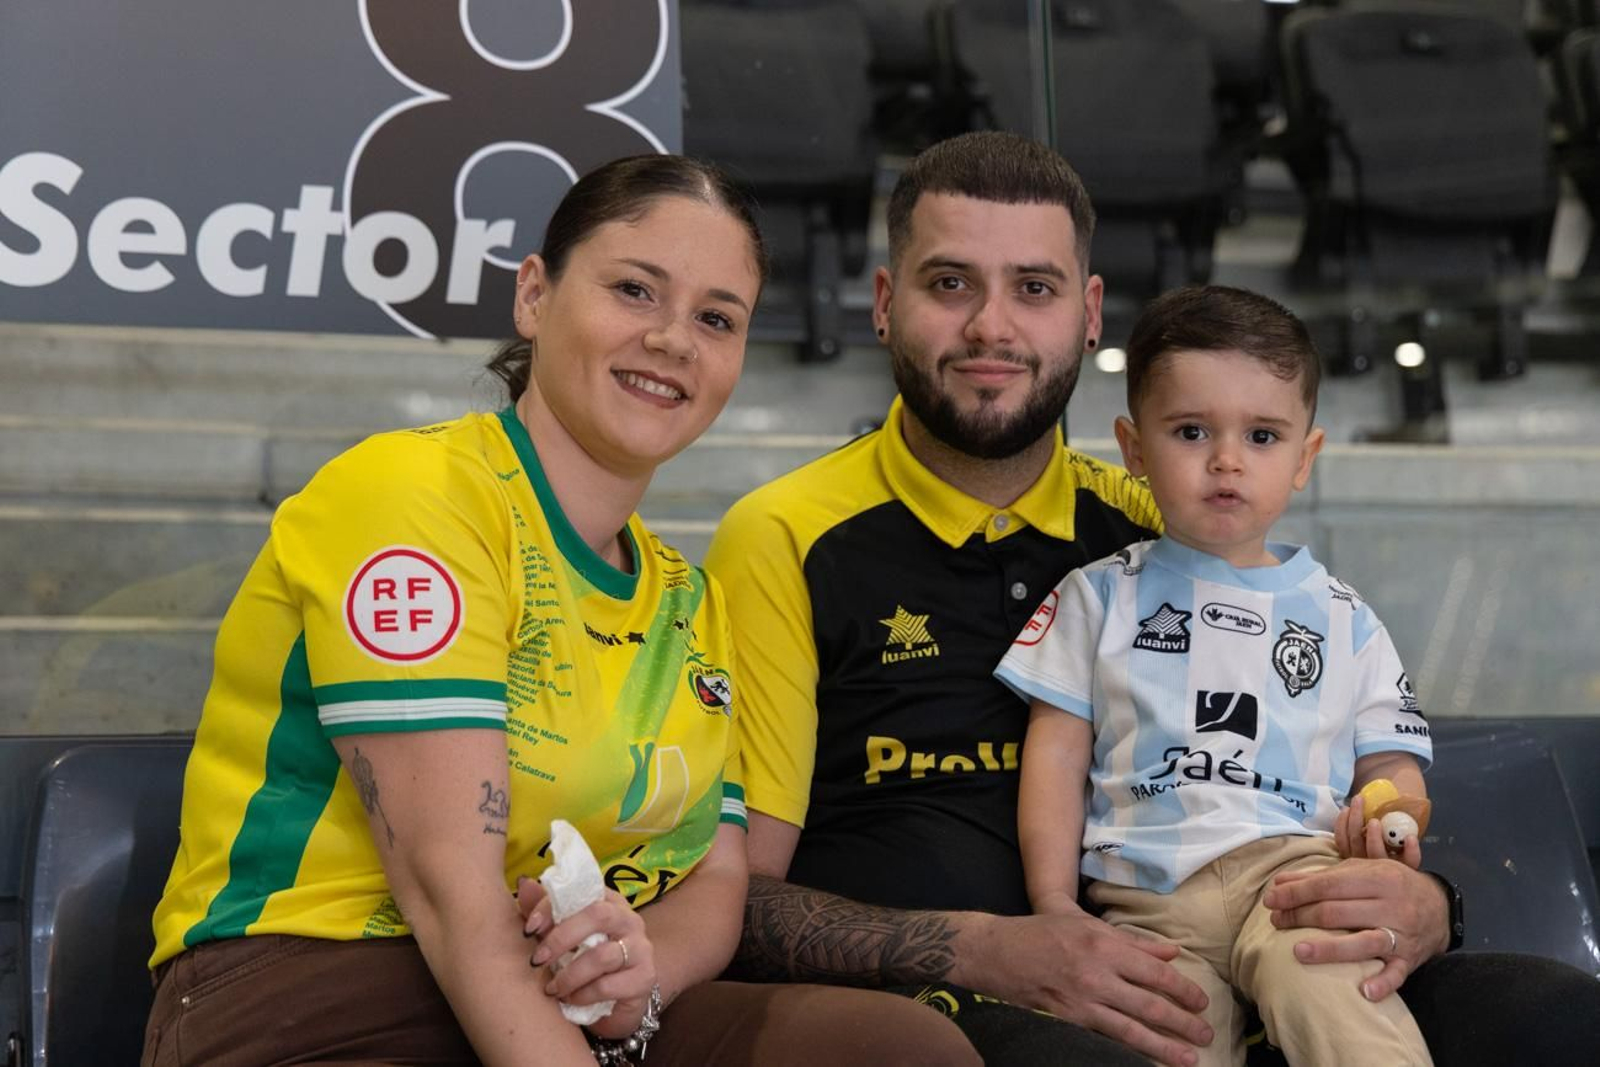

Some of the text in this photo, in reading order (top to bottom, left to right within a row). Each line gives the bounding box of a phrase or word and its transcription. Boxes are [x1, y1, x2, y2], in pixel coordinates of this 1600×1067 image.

[0, 152, 515, 305] Sector
[1136, 632, 1187, 651] luanvi
[881, 643, 940, 665] luanvi
[507, 718, 568, 745] anta de Martos
[522, 731, 539, 746] Rey
[1394, 723, 1430, 738] SANI
[515, 761, 556, 782] Calatrava
